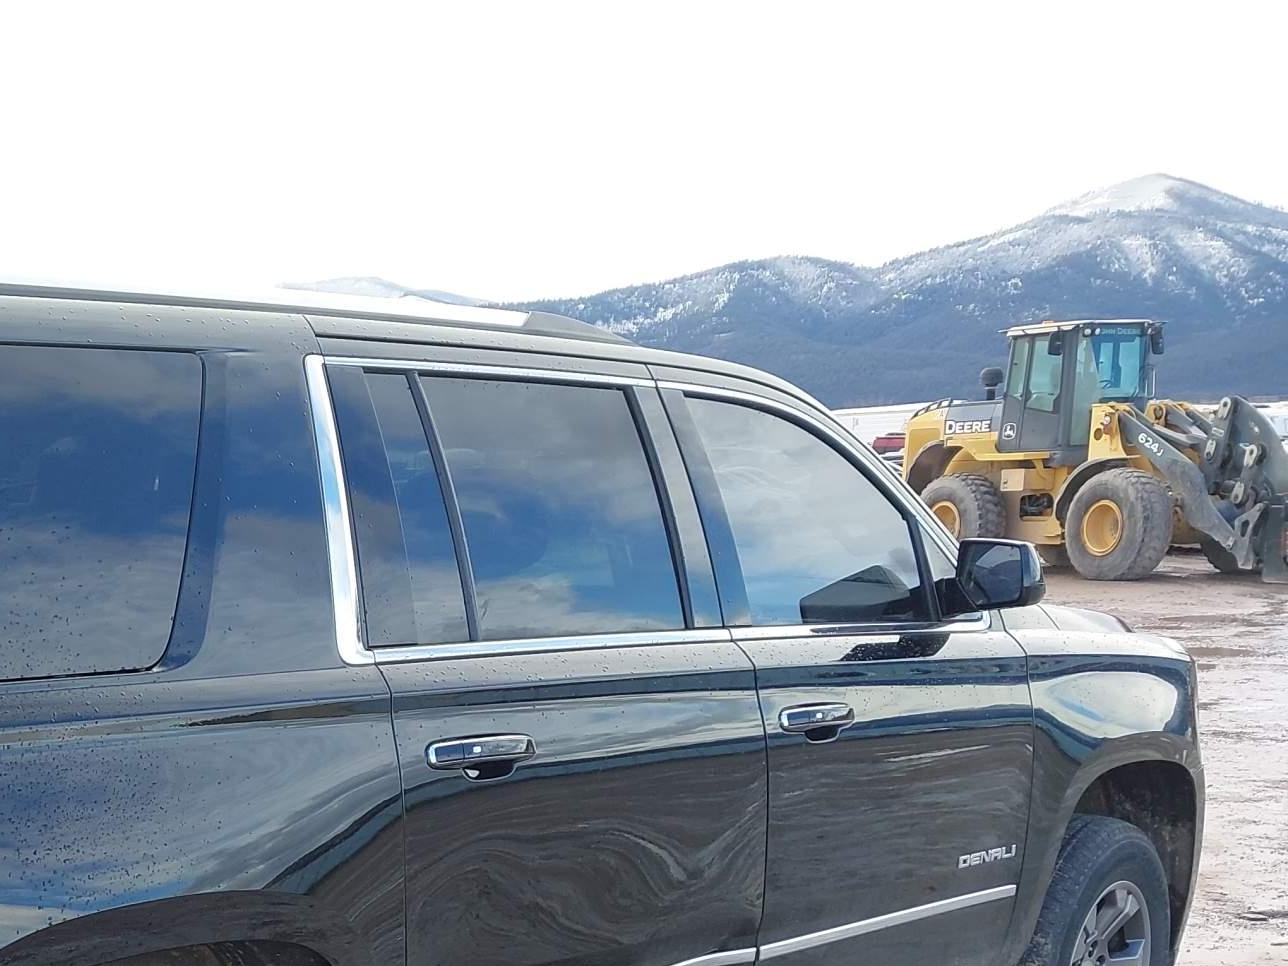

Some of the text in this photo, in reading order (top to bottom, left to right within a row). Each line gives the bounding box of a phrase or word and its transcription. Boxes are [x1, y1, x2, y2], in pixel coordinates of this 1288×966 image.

[945, 420, 991, 434] DEERE
[1138, 432, 1164, 457] 624J
[958, 844, 1017, 869] DENALI
